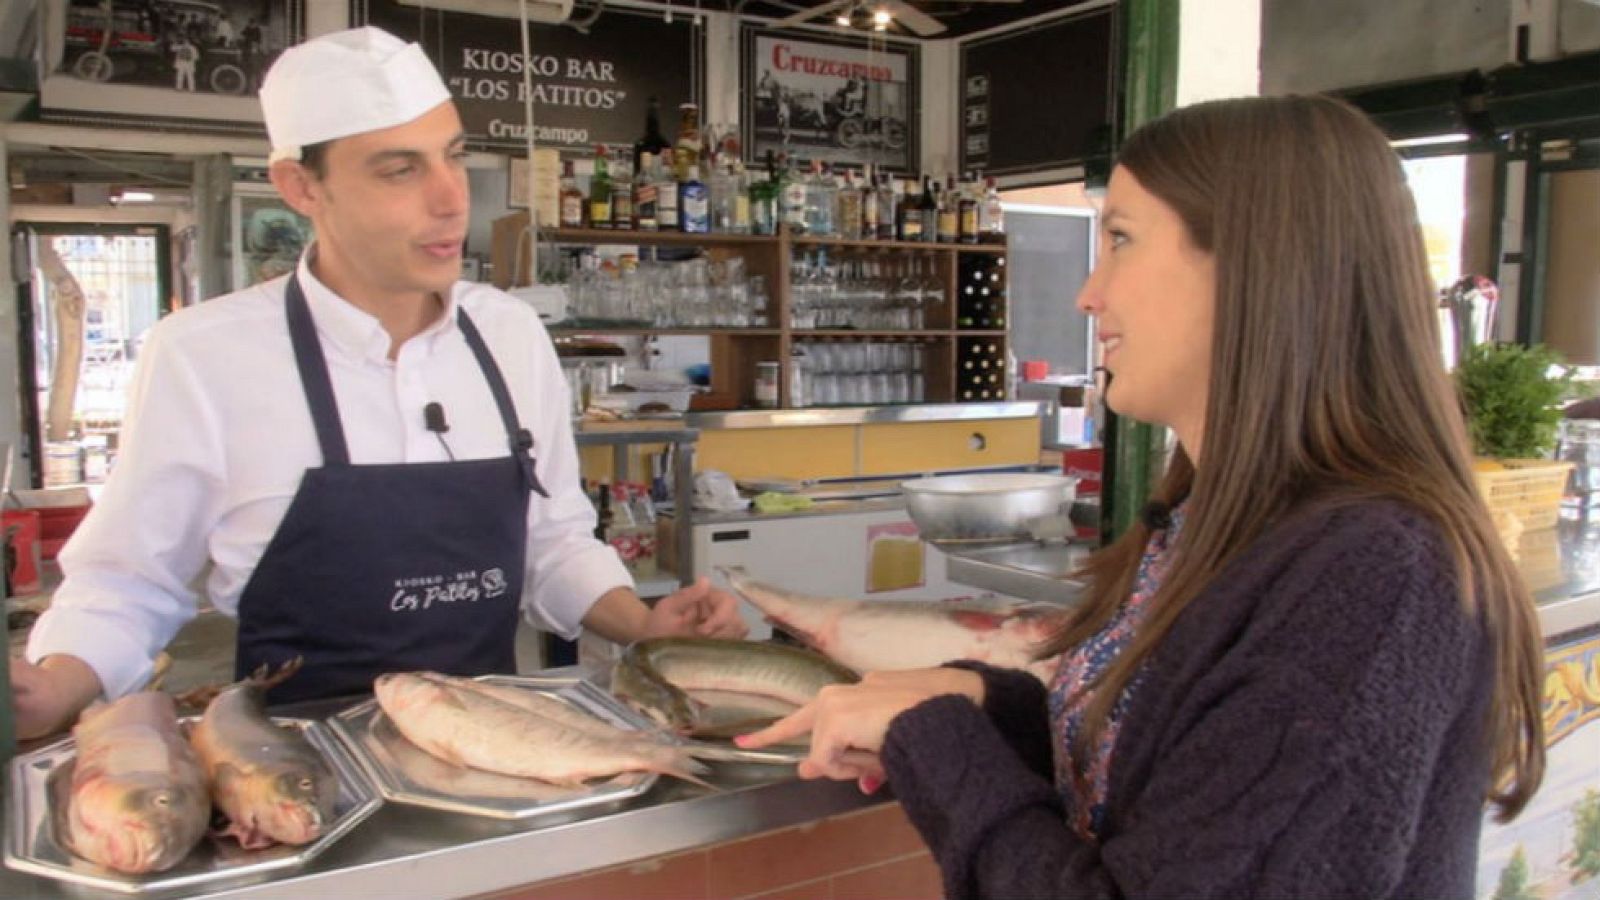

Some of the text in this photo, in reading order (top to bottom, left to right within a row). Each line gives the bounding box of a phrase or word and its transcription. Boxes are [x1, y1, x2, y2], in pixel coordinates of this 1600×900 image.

[462, 48, 616, 82] KIOSKO BAR
[488, 118, 589, 144] Cruzcampo
